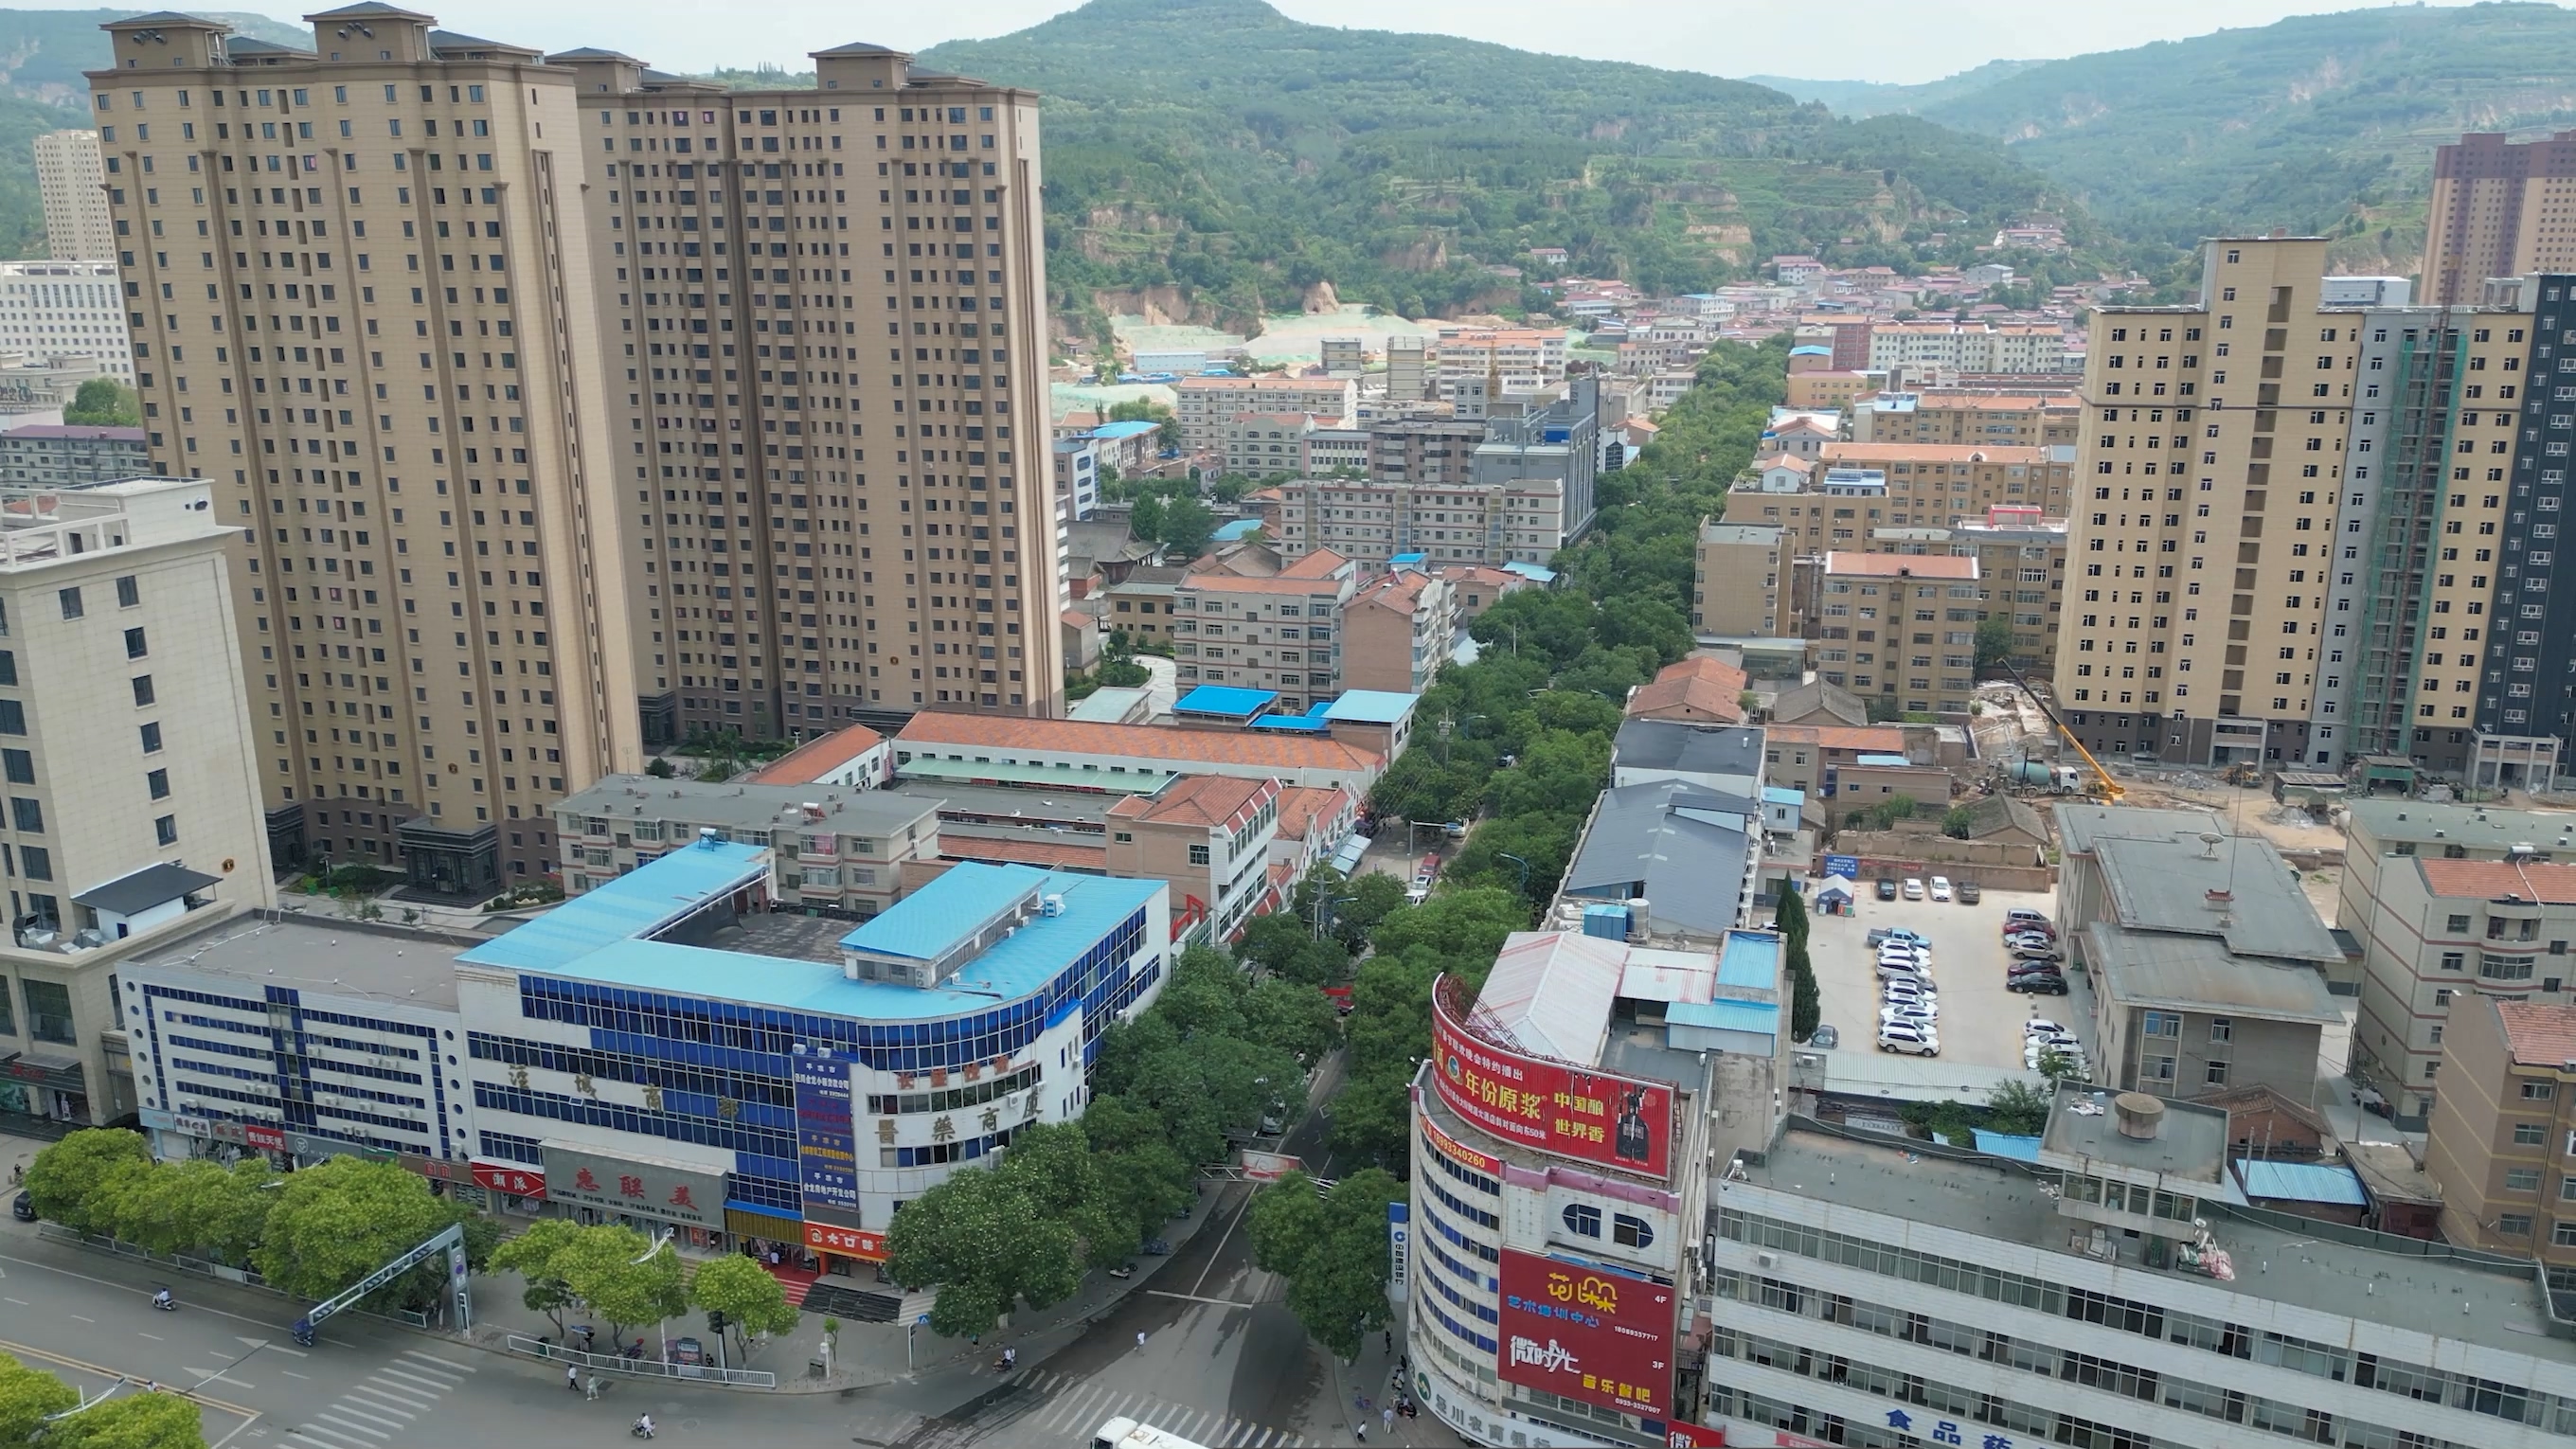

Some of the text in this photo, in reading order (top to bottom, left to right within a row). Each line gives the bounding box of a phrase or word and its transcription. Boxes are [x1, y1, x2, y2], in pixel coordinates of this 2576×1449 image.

[1464, 1069, 1541, 1120] 年份原浆
[1554, 1092, 1603, 1117] 中国酿
[1555, 1118, 1605, 1143] 世界香
[1508, 1295, 1600, 1328] 艺术培训中心
[1655, 1295, 1668, 1304] 4F
[1510, 1334, 1582, 1374] 微时光
[1652, 1360, 1665, 1370] 3F
[1583, 1373, 1651, 1404] 音乐餐吧
[1886, 1409, 2046, 1449] 食品药
